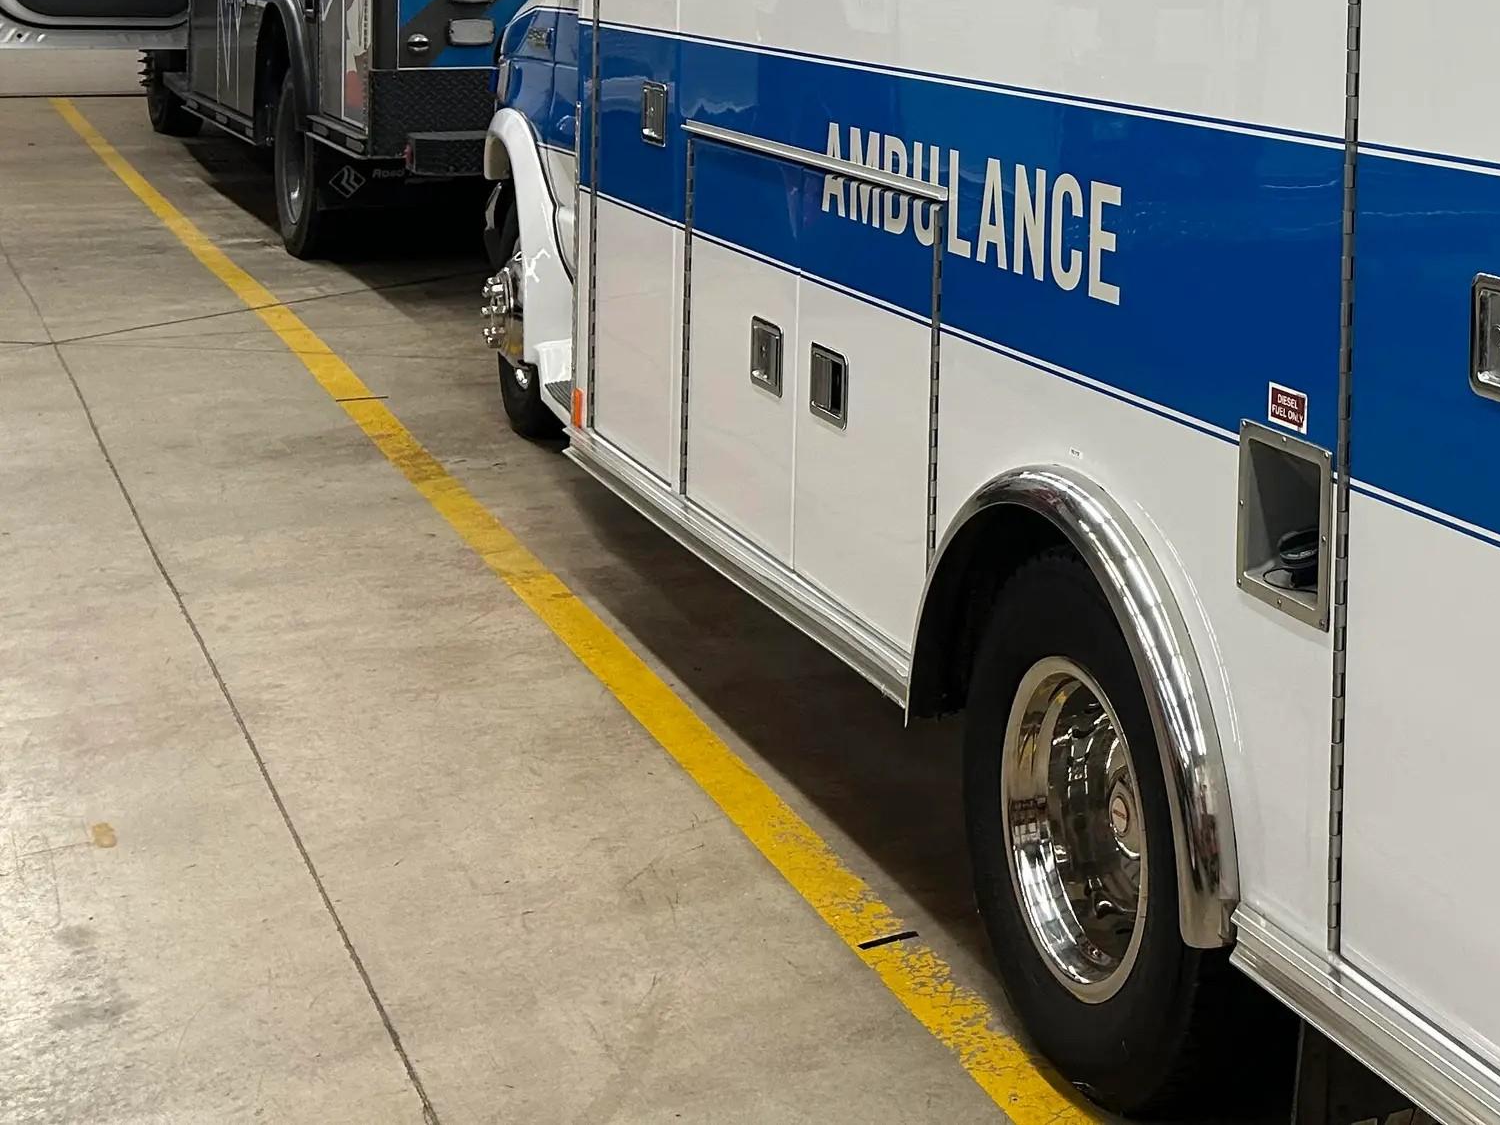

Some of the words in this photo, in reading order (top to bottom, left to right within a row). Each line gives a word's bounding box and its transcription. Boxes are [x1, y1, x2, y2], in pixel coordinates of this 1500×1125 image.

[821, 122, 1121, 306] AMBULANCE
[1277, 393, 1298, 410] DIESEL
[1271, 404, 1287, 418] FUEL
[1288, 410, 1304, 423] ONLY
